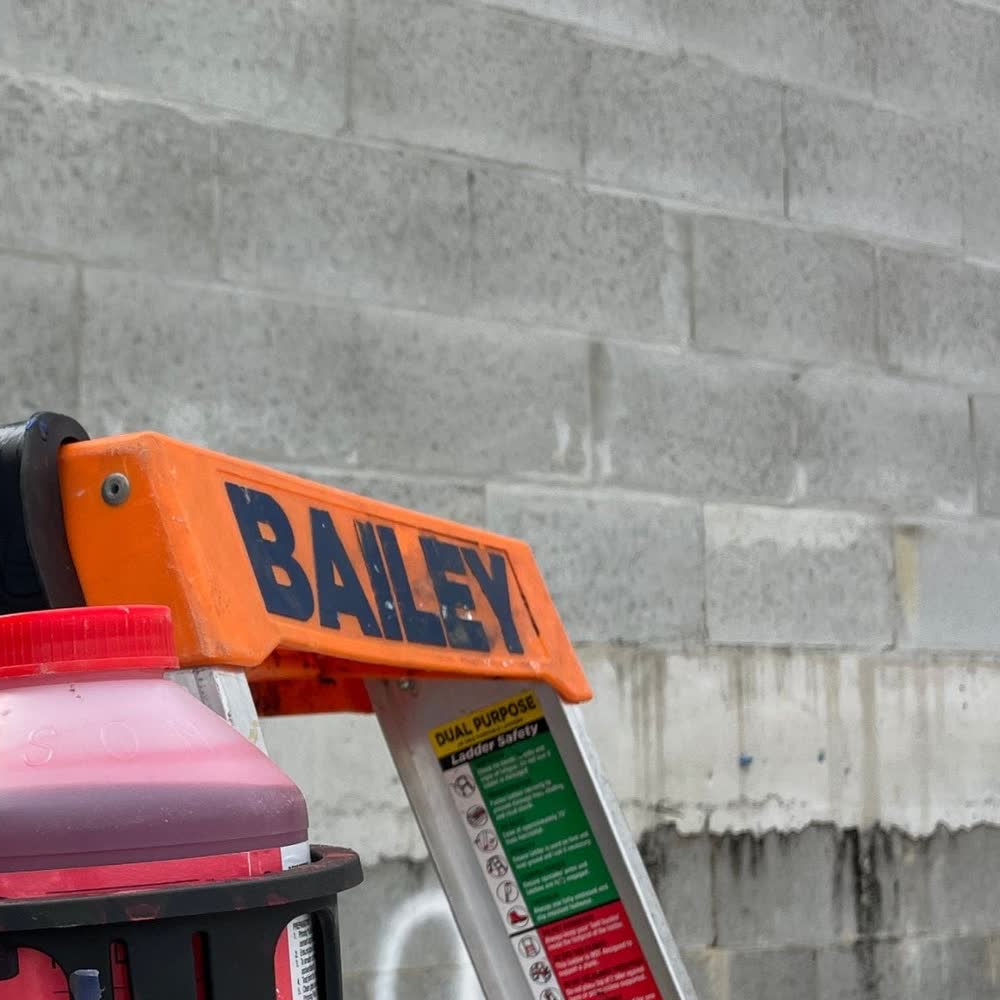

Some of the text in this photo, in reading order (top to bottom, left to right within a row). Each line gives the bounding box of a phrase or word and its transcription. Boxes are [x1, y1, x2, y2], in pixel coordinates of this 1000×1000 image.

[225, 482, 524, 655] BAILEY
[434, 723, 472, 747] DUAL
[473, 695, 537, 731] PURPOSE
[450, 740, 495, 766] Ladder
[497, 722, 539, 748] Safety
